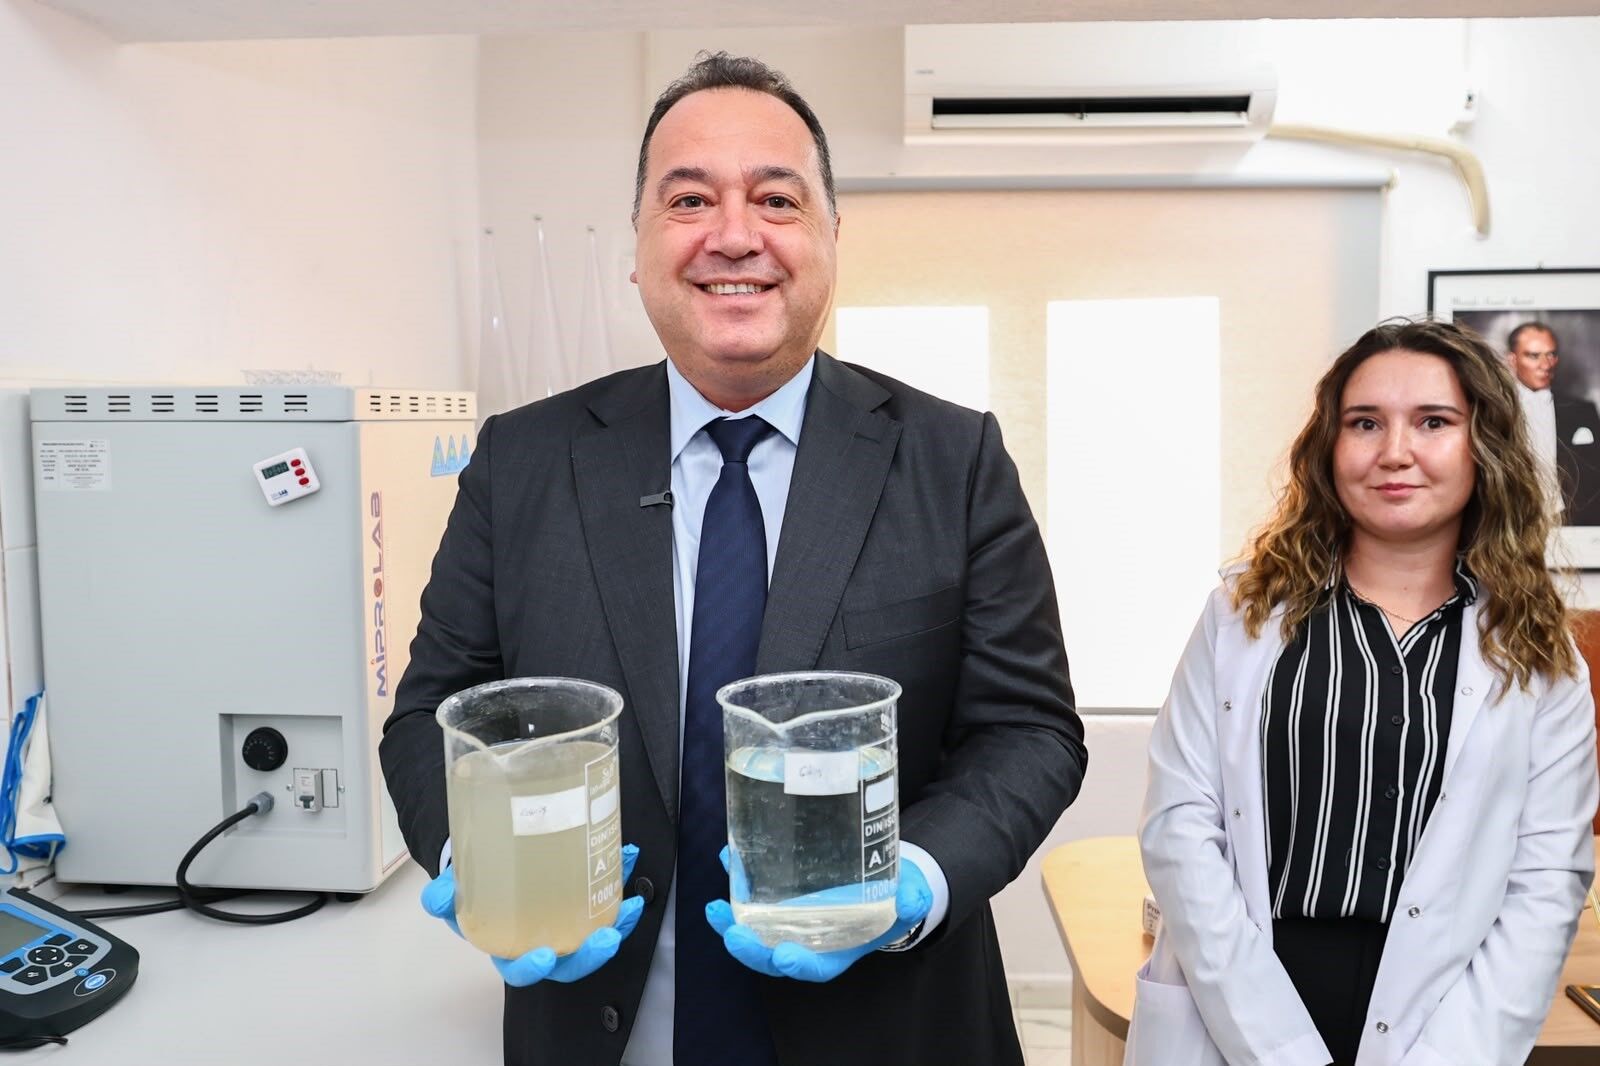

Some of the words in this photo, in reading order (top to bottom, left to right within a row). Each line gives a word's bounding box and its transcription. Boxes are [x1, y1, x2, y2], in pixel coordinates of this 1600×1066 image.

[865, 821, 882, 837] DIN
[591, 830, 607, 847] DIN
[595, 858, 607, 876] A
[869, 849, 881, 868] A
[592, 883, 613, 906] 1000
